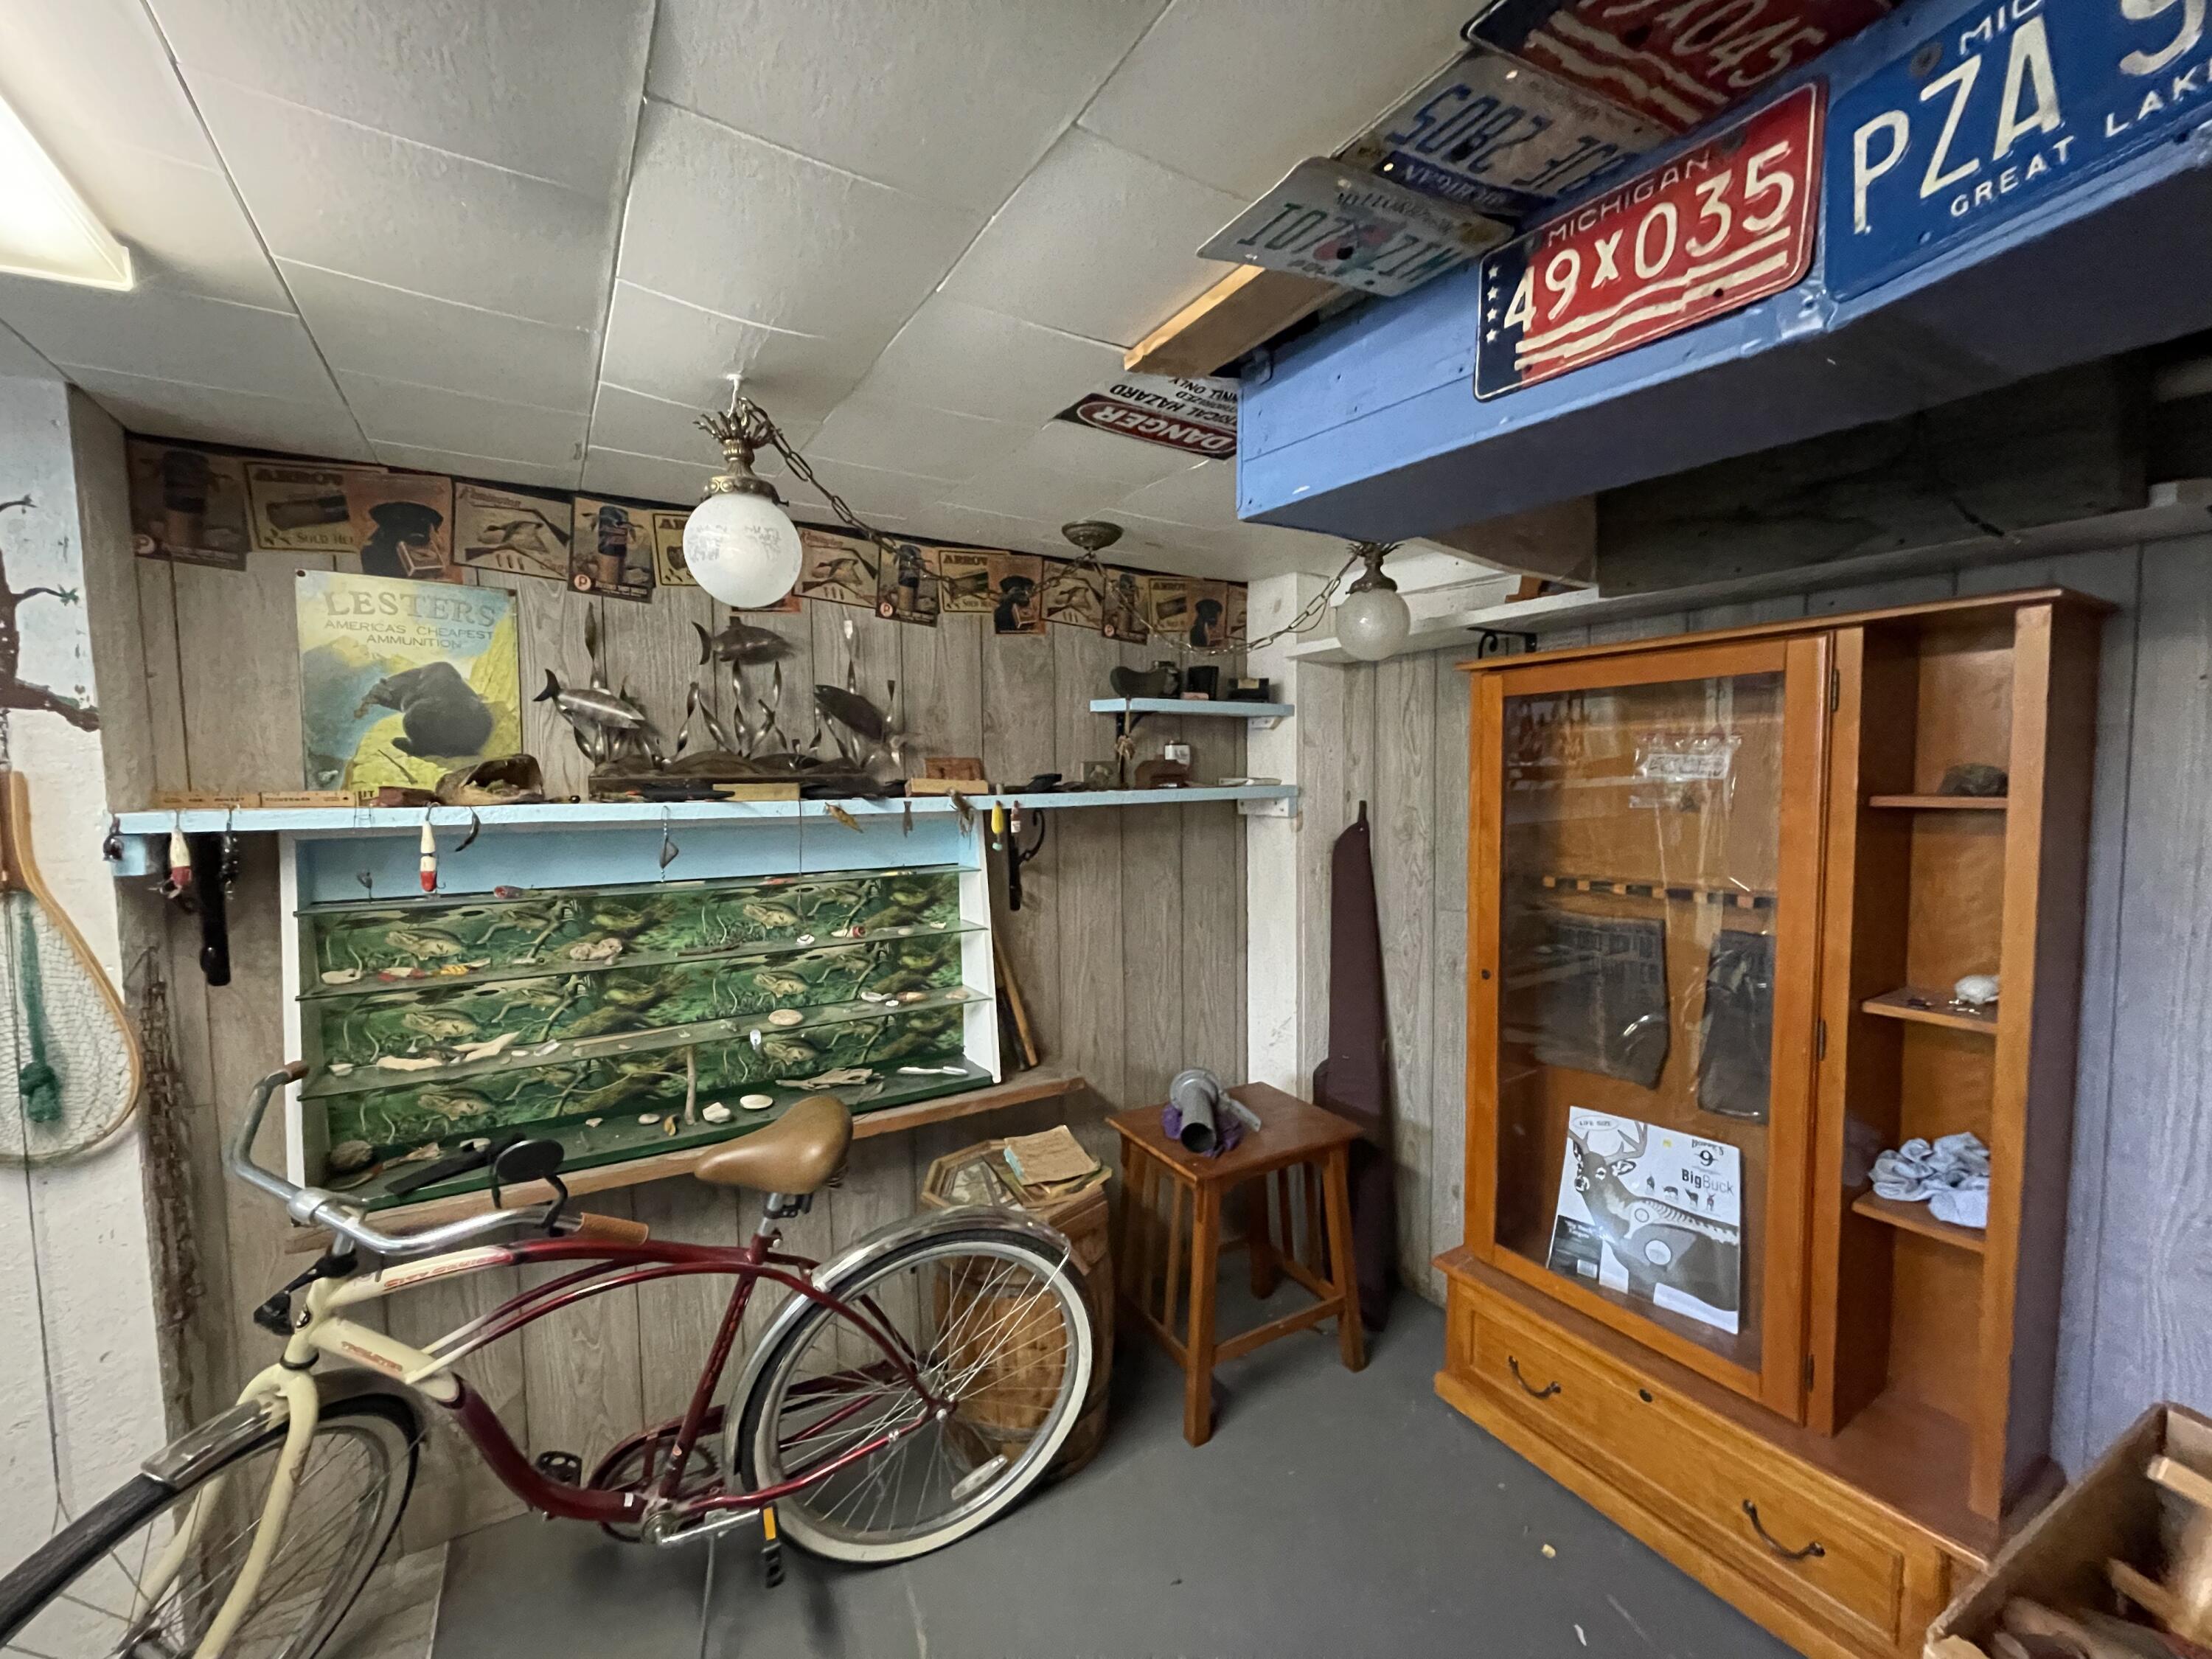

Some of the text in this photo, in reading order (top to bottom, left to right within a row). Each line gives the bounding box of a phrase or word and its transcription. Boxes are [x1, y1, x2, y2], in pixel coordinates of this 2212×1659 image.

[1383, 83, 1553, 174] 2805
[1853, 15, 2062, 234] PZA
[1950, 58, 2212, 217] GREAT LAK
[1548, 147, 1714, 247] MICHIGAN
[1109, 383, 1186, 412] HAZARD
[1170, 377, 1206, 394] ONLY
[1092, 406, 1234, 450] DANGER
[323, 590, 495, 627] LESTERS
[366, 633, 462, 649] AMMUNITION
[416, 625, 493, 640] CHEAPEST
[1700, 1151, 1714, 1166] 9
